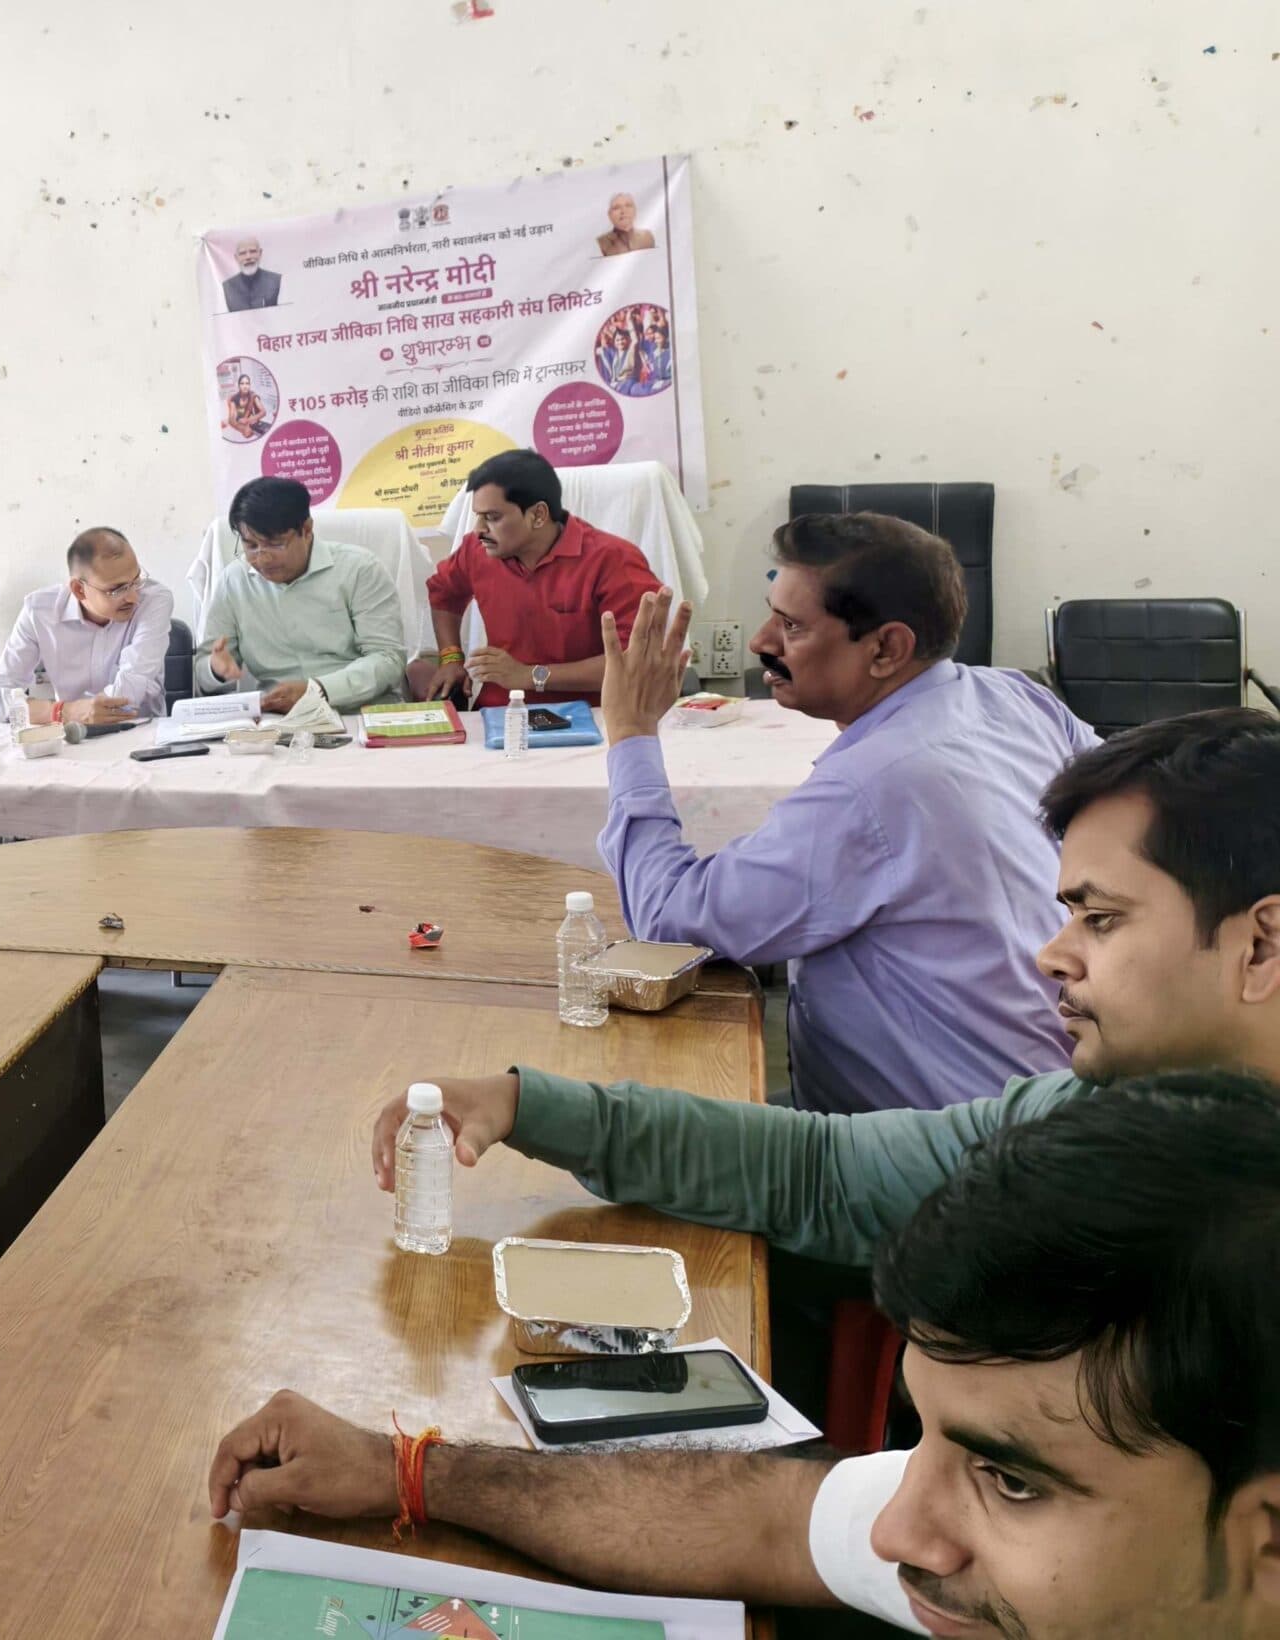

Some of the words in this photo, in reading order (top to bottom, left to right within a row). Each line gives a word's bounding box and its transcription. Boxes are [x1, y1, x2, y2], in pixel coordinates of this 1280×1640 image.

[303, 255, 336, 268] जीविका
[338, 251, 358, 264] निधि
[360, 249, 369, 260] से
[371, 242, 430, 258] आत्मनिर्भरता,
[432, 236, 450, 250] नारी
[453, 232, 496, 246] स्वावलंबन
[498, 227, 511, 240] को
[513, 224, 527, 238] नई
[350, 269, 379, 299] श्री
[384, 265, 439, 294] नरेन्द्र
[445, 253, 496, 285] मोदी
[257, 334, 292, 352] बिहार
[296, 329, 328, 346] राज्य
[331, 321, 382, 342] जीविका
[387, 314, 418, 334] निधि
[422, 311, 455, 330] साख
[458, 300, 514, 325] सहकारी
[518, 296, 543, 316] संघ
[548, 288, 603, 312] लिमिटेड
[401, 335, 471, 365] शुभारम्भ
[288, 395, 327, 412] ₹105
[330, 386, 369, 408] करोड़
[372, 384, 388, 402] की
[392, 382, 418, 400] राशि
[422, 382, 439, 396] का
[443, 374, 488, 393] जीविका
[493, 369, 520, 388] निधि
[523, 365, 532, 381] में
[459, 400, 468, 410] के
[469, 399, 483, 411] द्वारा
[395, 446, 408, 460] श्री
[412, 443, 443, 458] नीतीश
[447, 439, 474, 456] कुमार
